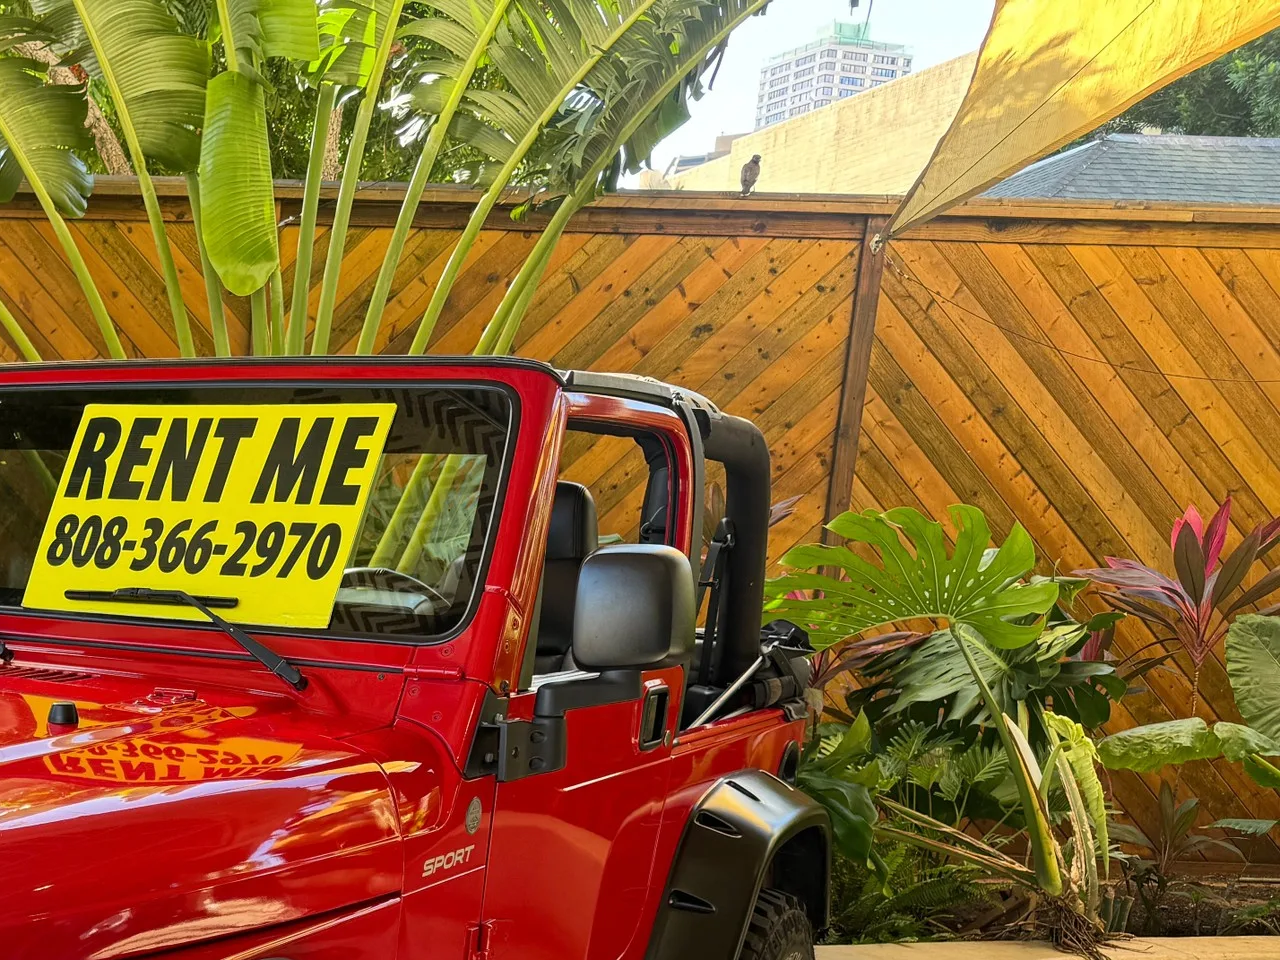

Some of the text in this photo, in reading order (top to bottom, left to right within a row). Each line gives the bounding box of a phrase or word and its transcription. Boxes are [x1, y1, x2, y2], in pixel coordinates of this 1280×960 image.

[64, 416, 380, 506] RENT ME
[45, 513, 343, 580] 808-366-2970
[422, 844, 475, 877] SPORT
